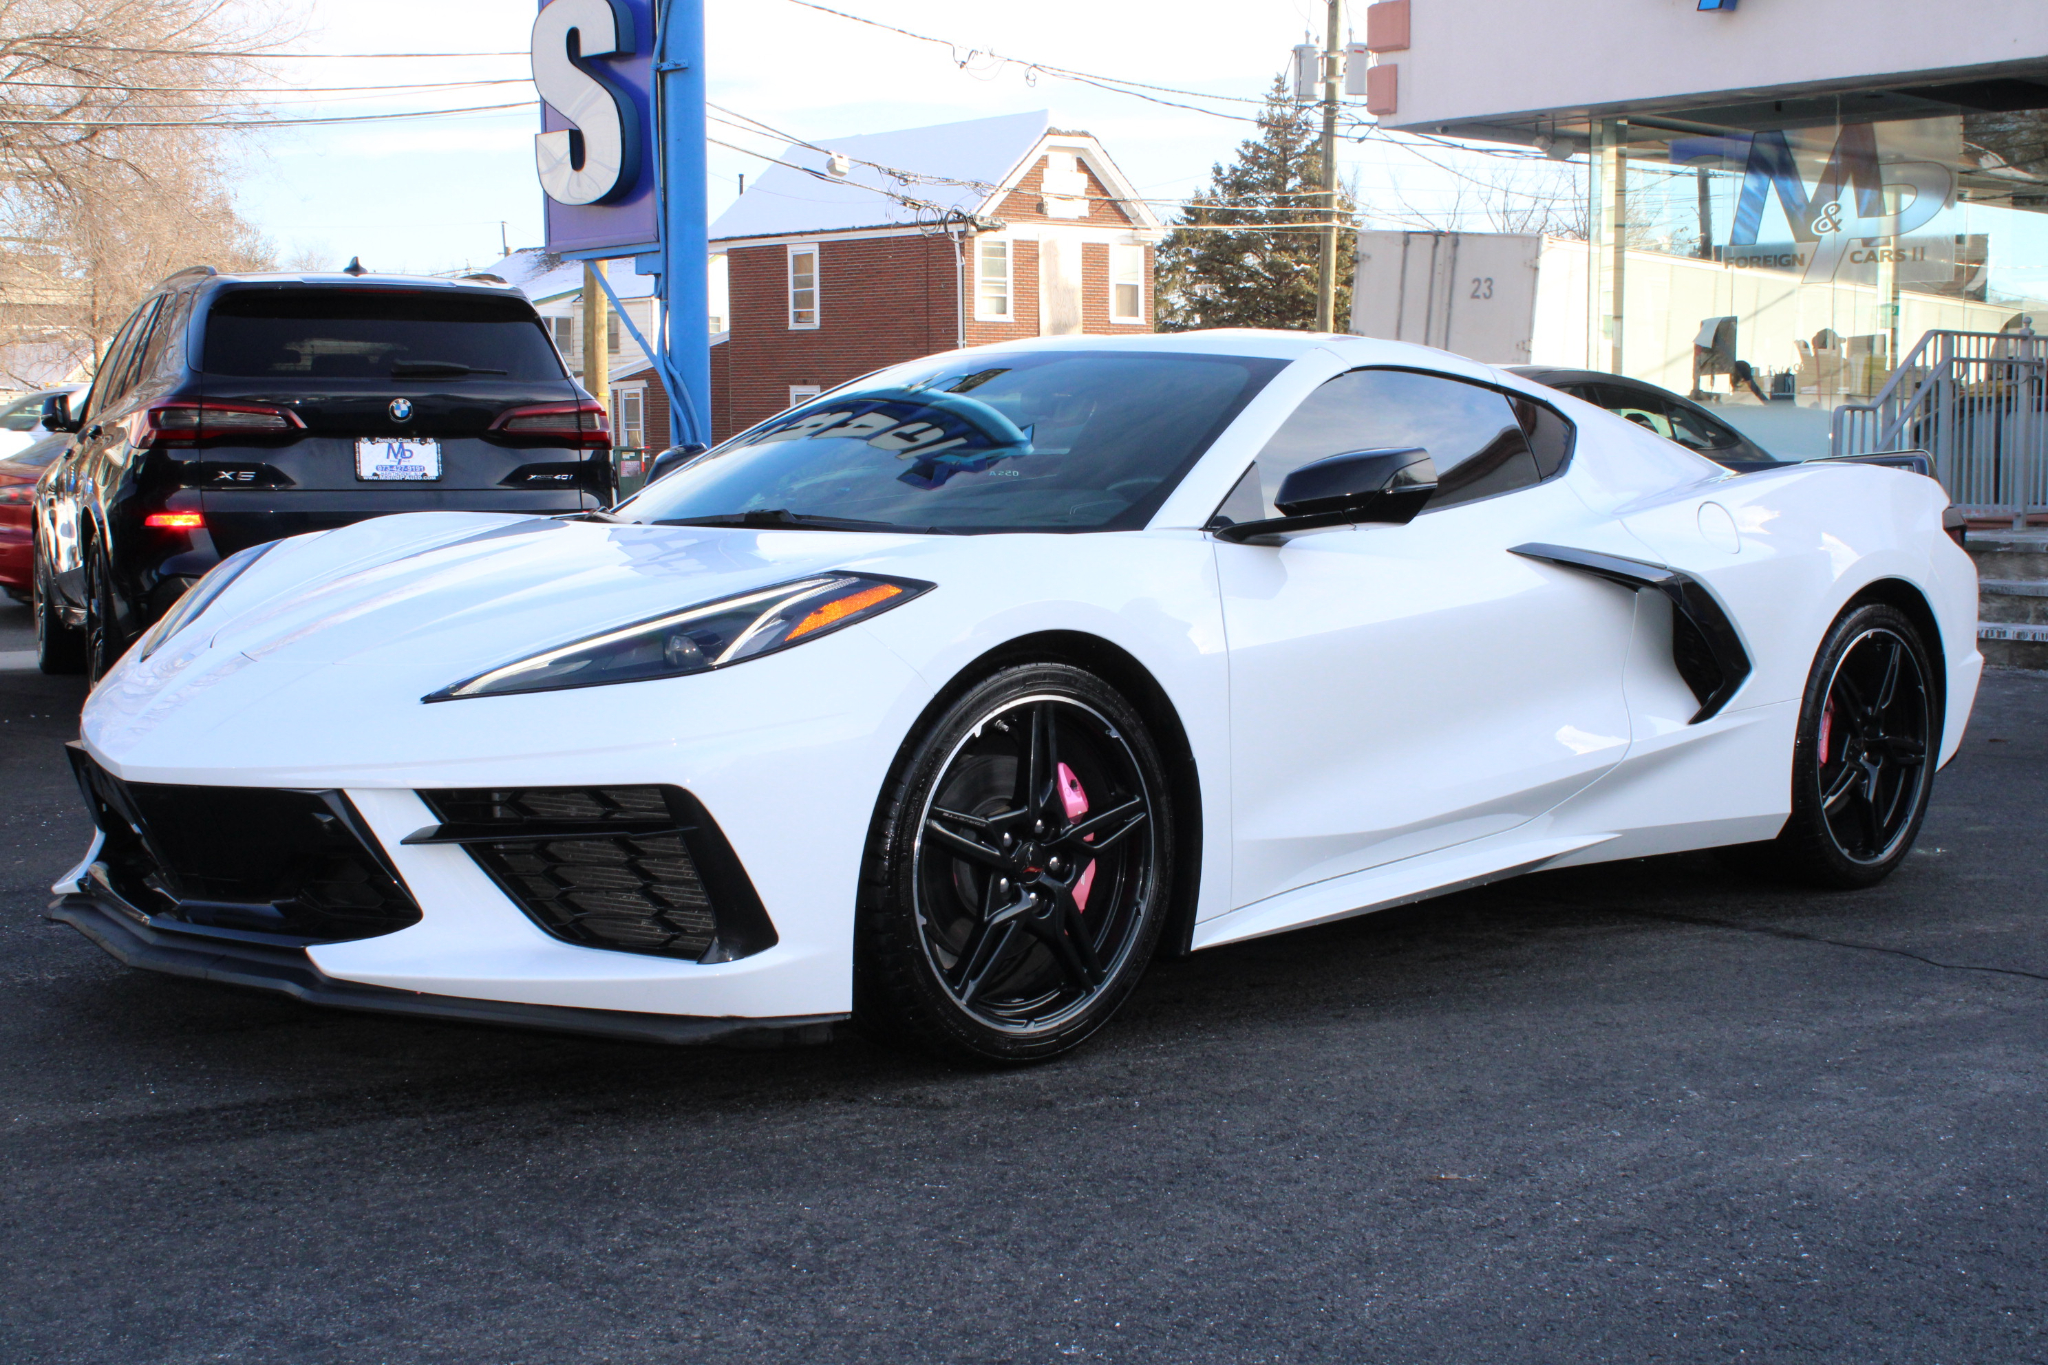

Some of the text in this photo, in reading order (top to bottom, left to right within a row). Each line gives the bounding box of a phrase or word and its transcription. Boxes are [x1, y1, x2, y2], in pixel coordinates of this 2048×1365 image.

[531, 0, 625, 206] S
[1724, 253, 1805, 269] FOREIGN
[1850, 249, 1906, 264] CARS
[1470, 277, 1494, 300] 23
[213, 471, 256, 481] X5
